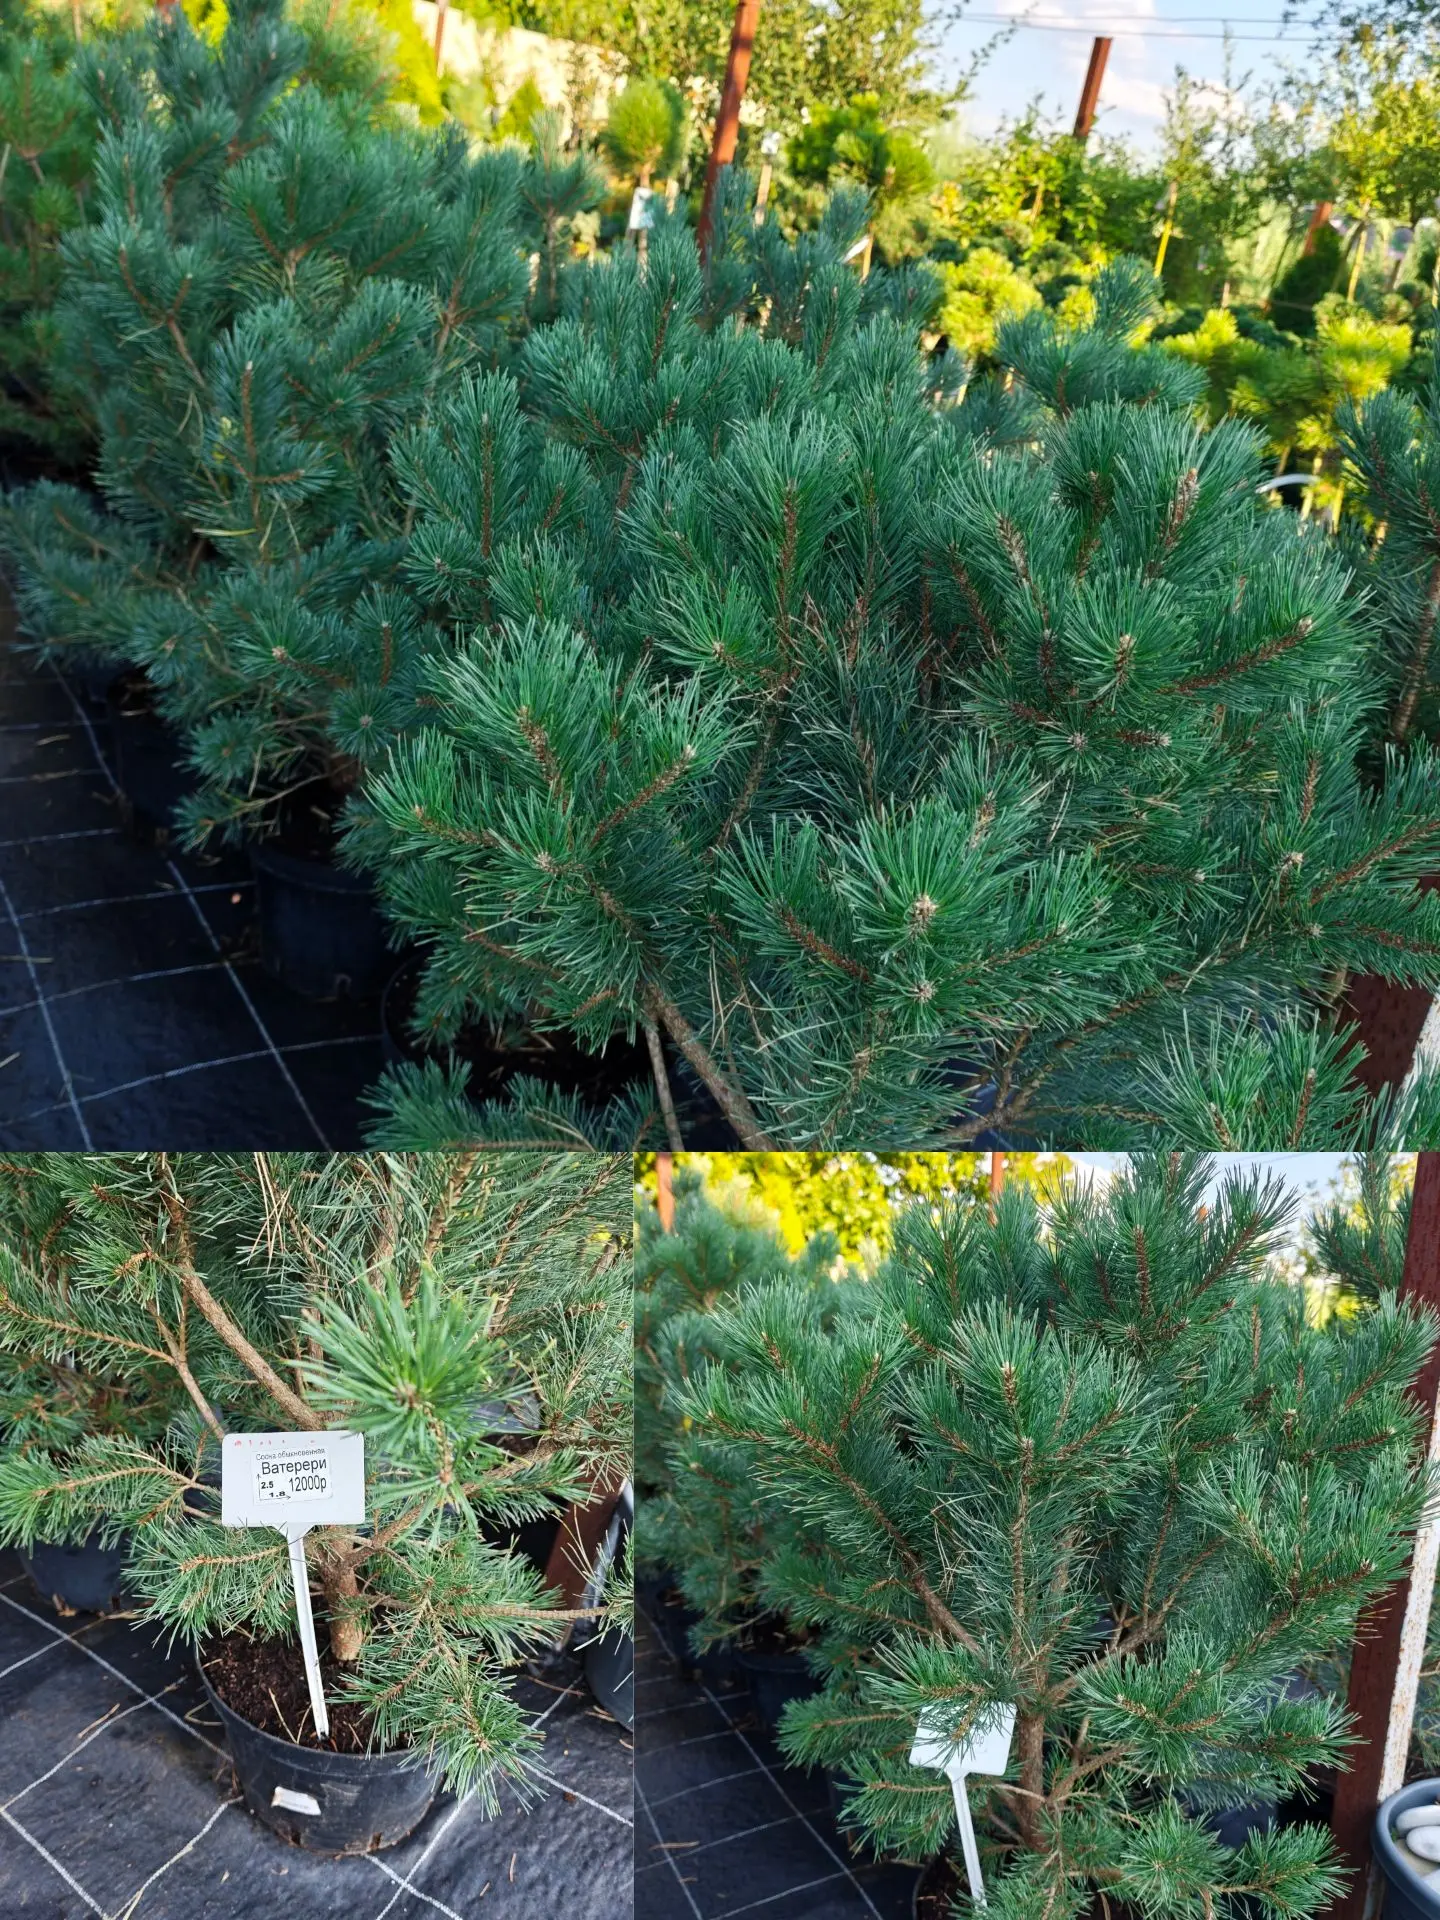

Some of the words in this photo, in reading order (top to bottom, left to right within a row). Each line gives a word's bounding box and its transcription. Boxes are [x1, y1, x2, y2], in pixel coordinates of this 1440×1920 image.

[261, 1458, 327, 1475] Ватерери
[260, 1480, 274, 1490] 2.5
[288, 1474, 327, 1493] 12000р
[268, 1490, 286, 1498] 1.8
